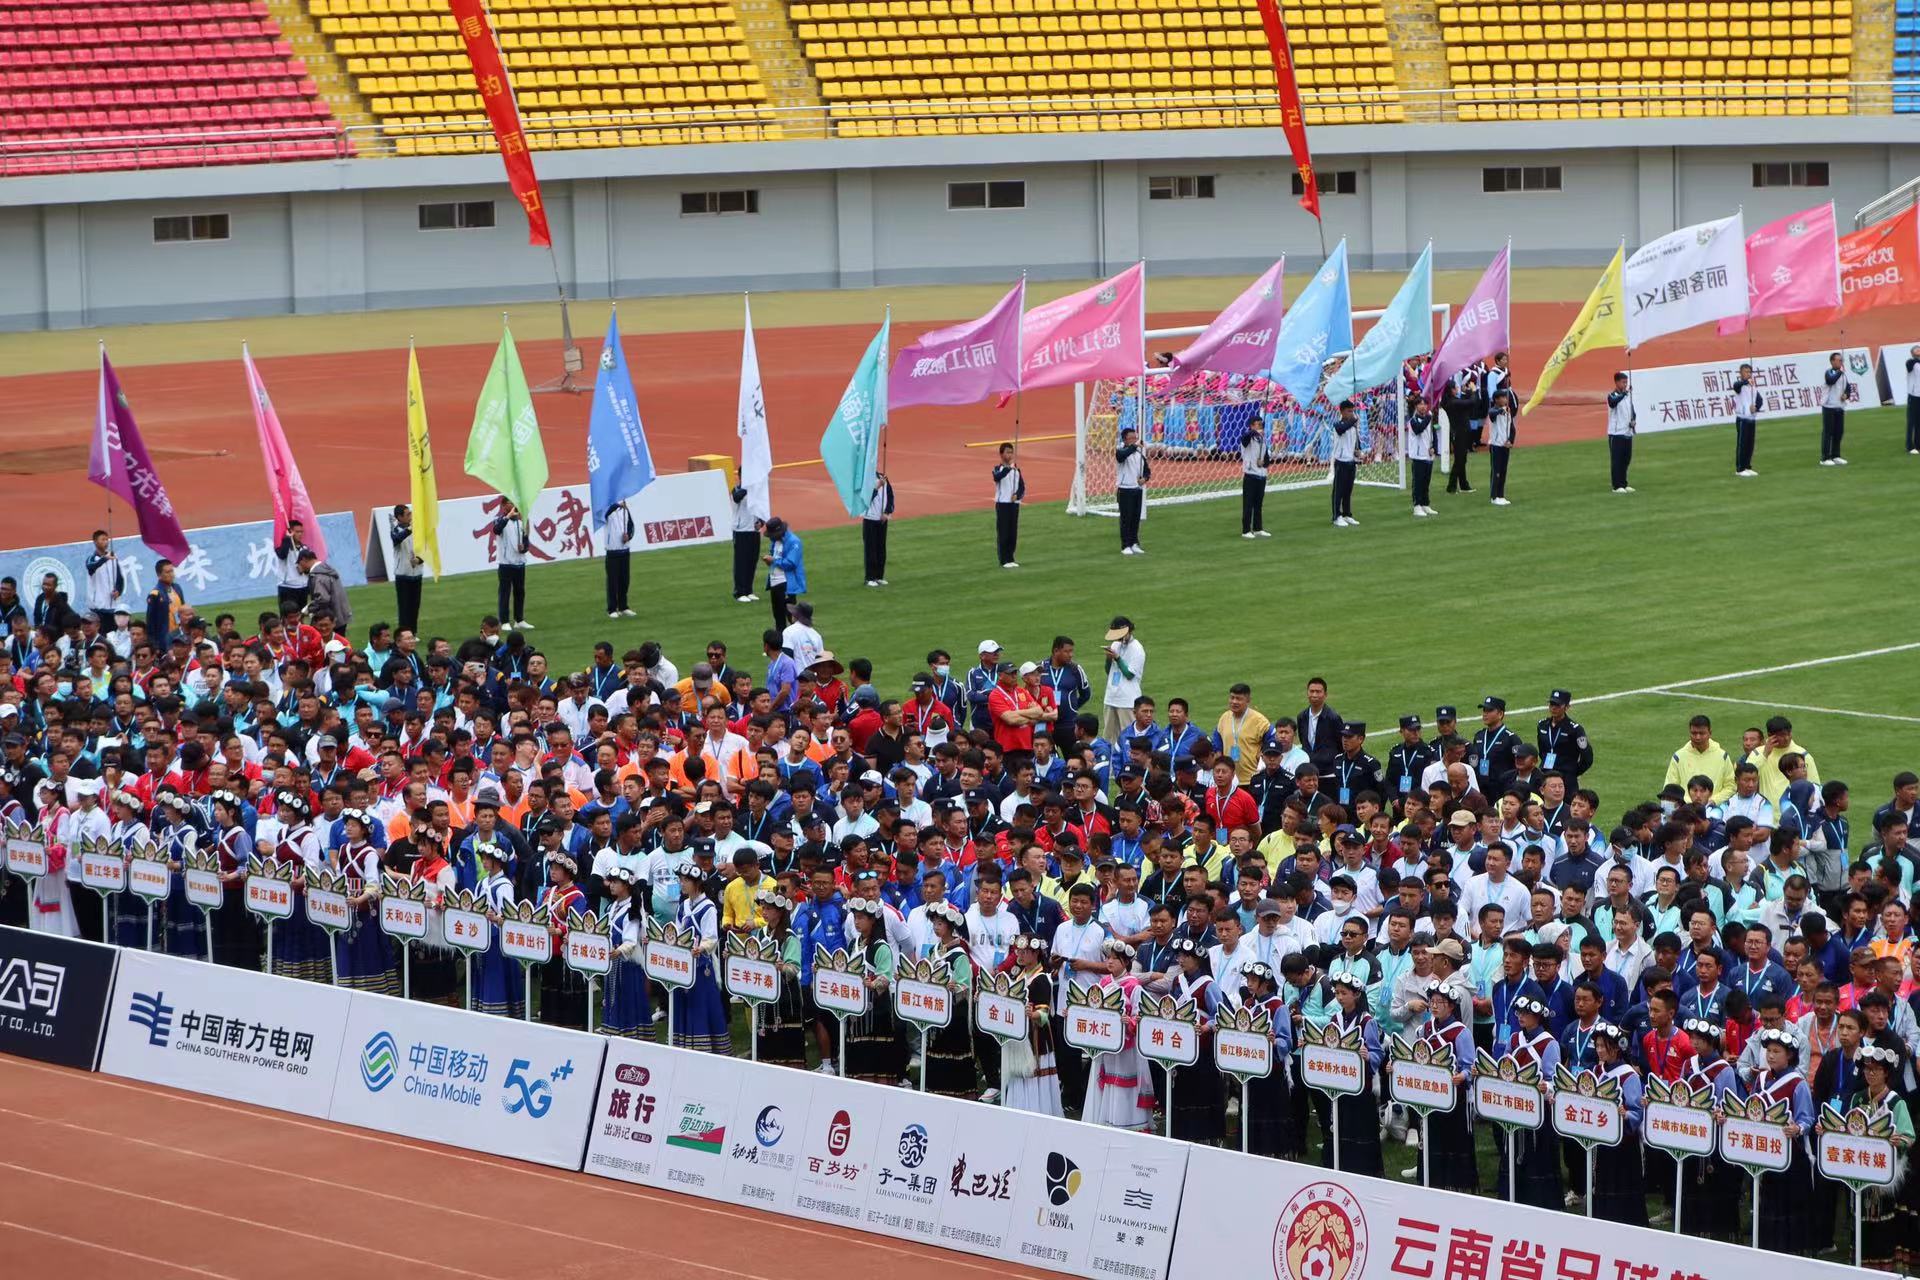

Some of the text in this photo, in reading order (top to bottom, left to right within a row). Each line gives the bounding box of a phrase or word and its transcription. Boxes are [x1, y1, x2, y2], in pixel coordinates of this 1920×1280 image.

[1701, 363, 1801, 394] 丽江古城区
[385, 907, 424, 926] 天和公司
[455, 921, 479, 938] 金沙
[505, 931, 547, 951] 滴滴出行
[571, 943, 607, 961] 古城公安
[649, 953, 689, 974] 丽江供电局
[731, 967, 774, 989] 三羊开泰
[819, 980, 861, 1001] 三朵园林
[900, 991, 945, 1013] 丽江畅旅
[988, 1005, 1015, 1025] 金山
[180, 1010, 314, 1062] 中国南方电网
[1076, 1018, 1112, 1037] 丽水汇
[1151, 1028, 1183, 1049] 纳合
[176, 1041, 309, 1076] CHINA SOUTHERN POWER GRID
[408, 1041, 489, 1083] 中国移动
[1220, 1043, 1267, 1061] 丽江移动公司
[1307, 1060, 1358, 1078] 金安桥水电站
[403, 1075, 482, 1107] China Mobile
[1396, 1074, 1450, 1095] 古城区应急局
[608, 1088, 656, 1124] 旅行
[683, 1103, 706, 1116] 丽江
[1481, 1090, 1536, 1113] 丽江市国投
[1564, 1104, 1609, 1128] 金江乡
[1652, 1118, 1708, 1138] 古城市场监管
[1727, 1130, 1782, 1155] 宁蒗国投
[1826, 1146, 1887, 1169] 壹家传媒
[807, 1156, 860, 1181] 百岁坊
[912, 1194, 933, 1206] GROUP
[1107, 1215, 1122, 1225] SUN
[1122, 1217, 1148, 1231] ALWAYS
[1148, 1222, 1168, 1234] SHINE
